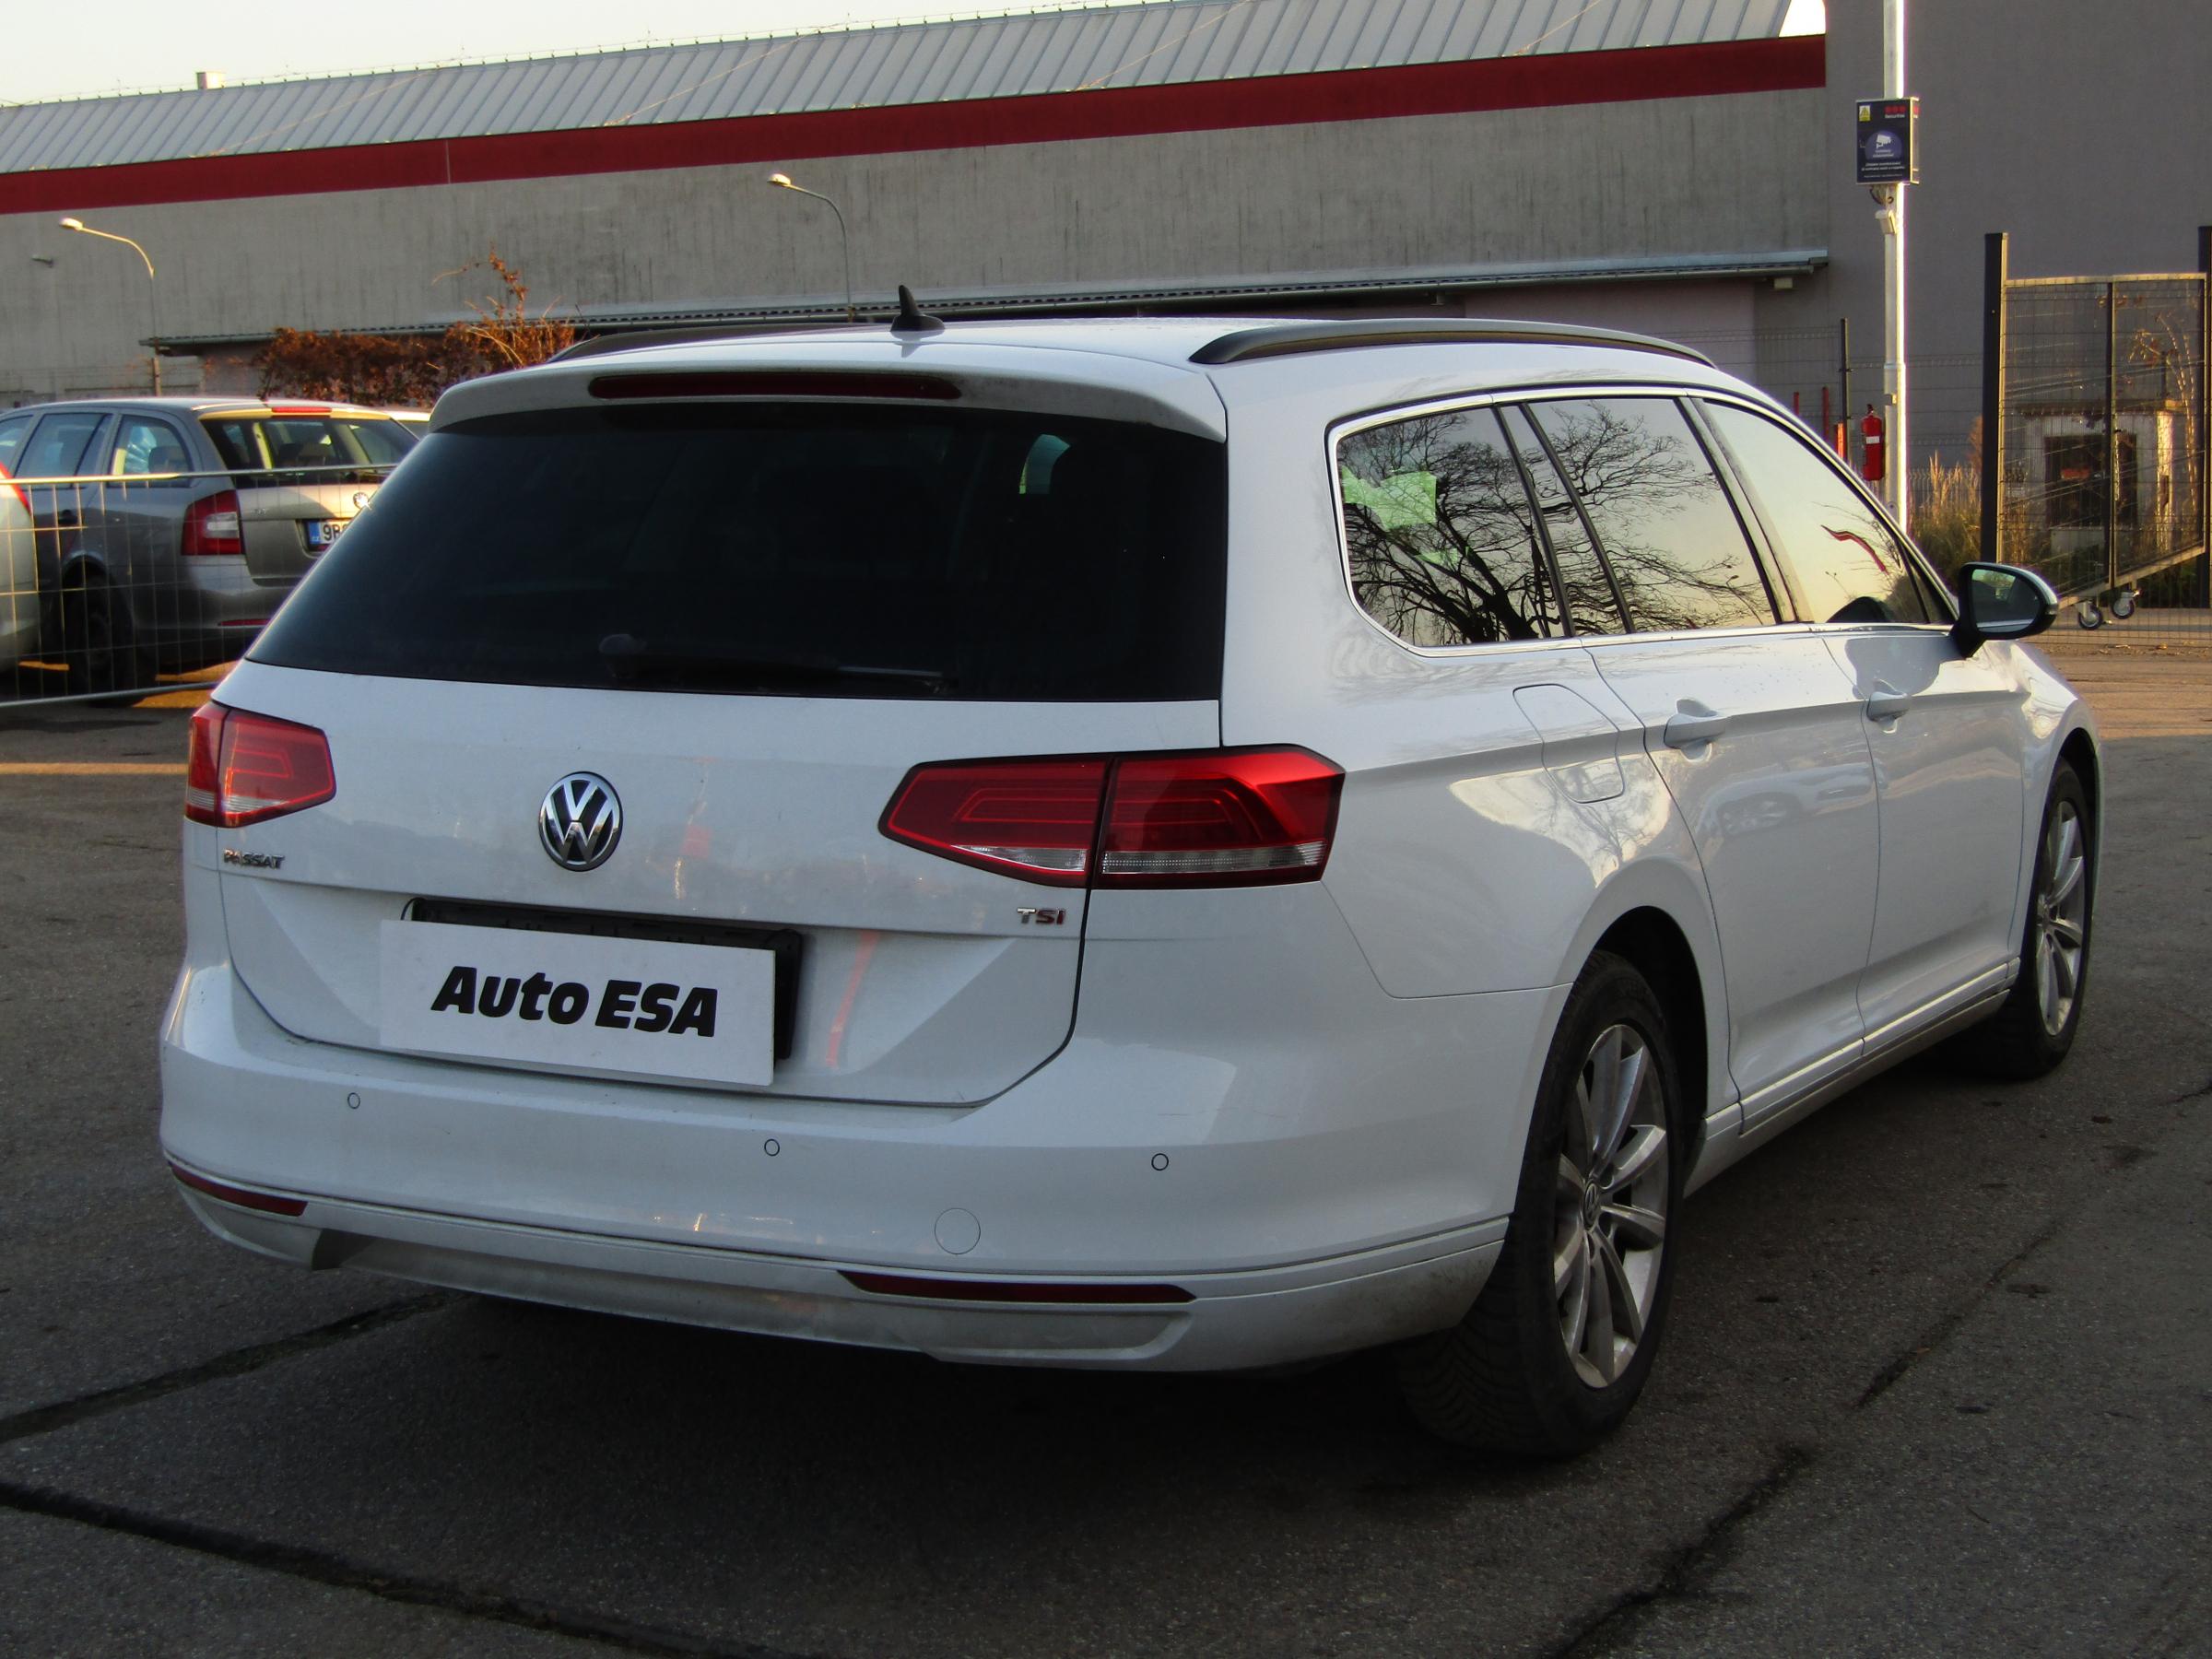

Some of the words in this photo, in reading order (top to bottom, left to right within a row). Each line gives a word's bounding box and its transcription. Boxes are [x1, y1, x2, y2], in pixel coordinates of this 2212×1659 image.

[224, 848, 285, 869] PASSAT
[1017, 908, 1065, 925] TSI
[430, 965, 589, 1025] Auto
[594, 979, 718, 1038] ESA
